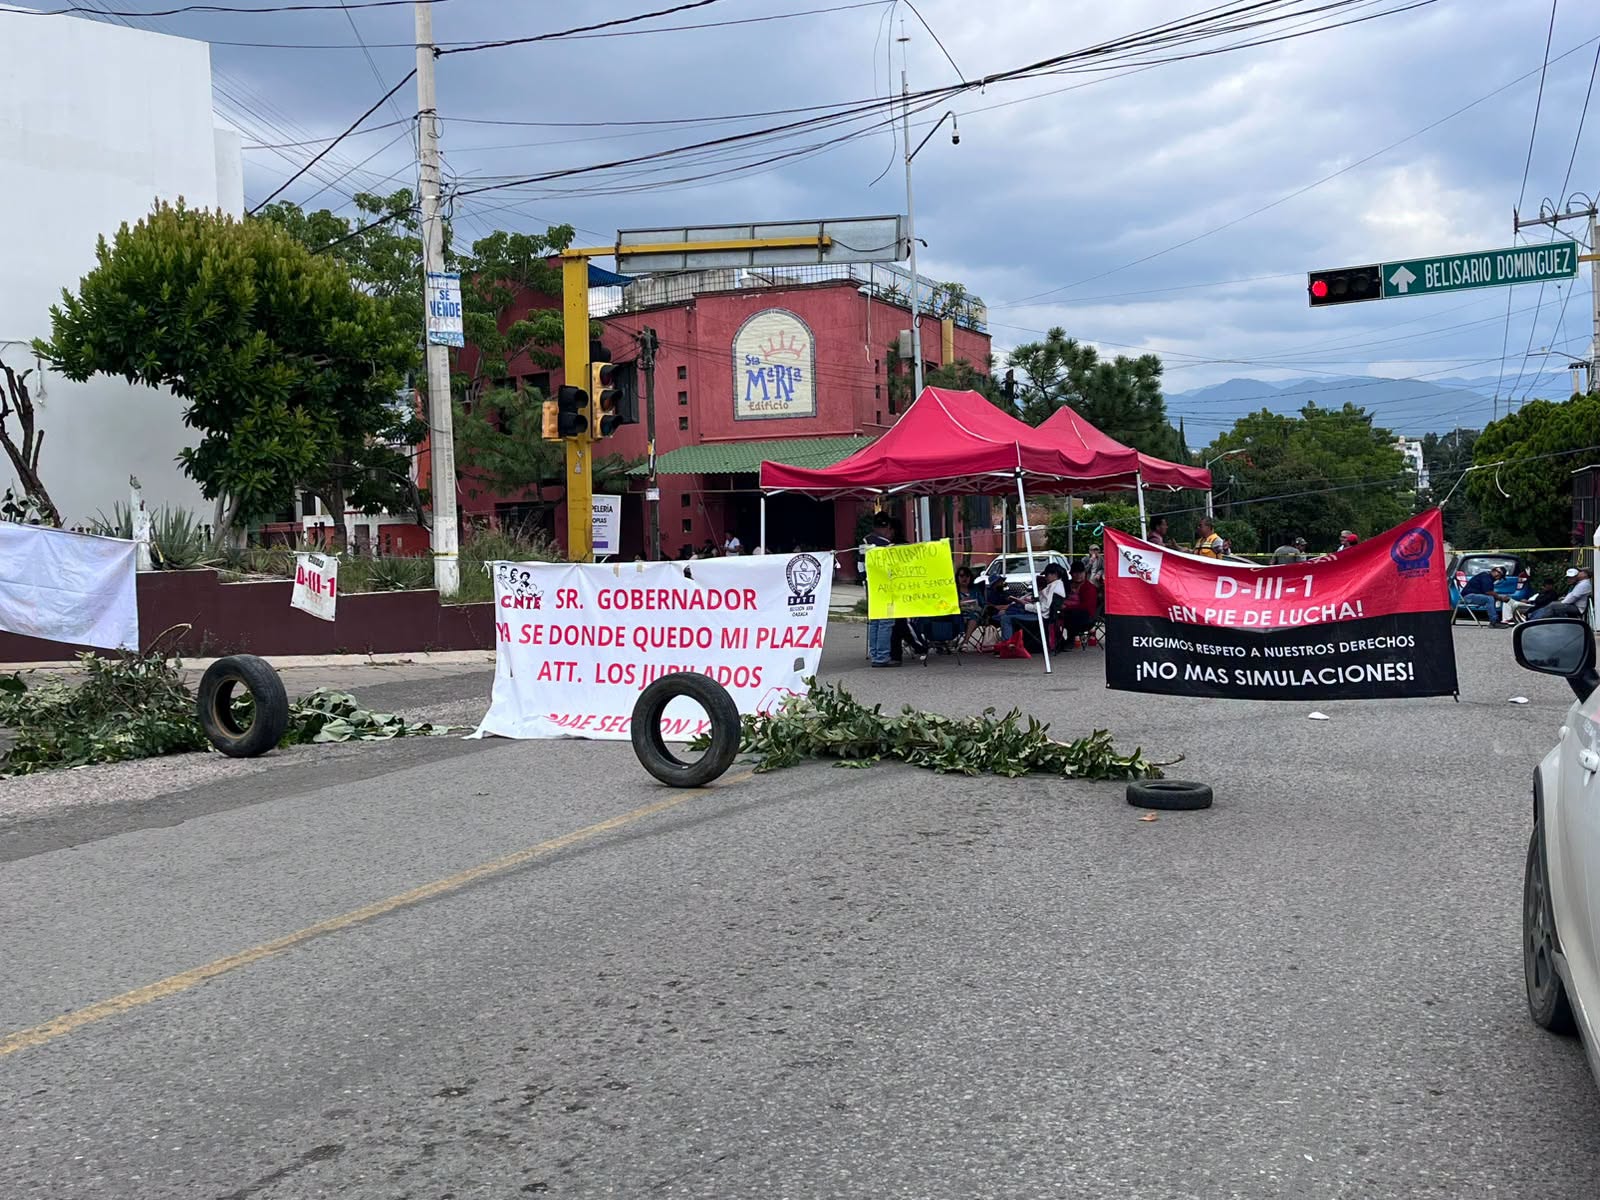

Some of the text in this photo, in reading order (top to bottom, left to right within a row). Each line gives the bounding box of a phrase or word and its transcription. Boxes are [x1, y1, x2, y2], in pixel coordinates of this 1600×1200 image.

[1425, 248, 1571, 288] BELISARIO DOMINGUEZ
[439, 290, 450, 300] SE
[430, 301, 461, 318] VENDE
[745, 355, 760, 365] Sta
[749, 401, 789, 411] Edificio
[1215, 574, 1313, 600] D-III-1
[501, 595, 541, 610] CNTE
[556, 588, 757, 610] SR. GOBERNADOR
[1168, 600, 1364, 626] ¡EN PIE DE LUCHA!
[519, 624, 543, 645] SE
[550, 625, 625, 647] DONDE
[633, 627, 712, 652] QUEDO
[721, 628, 748, 649] MI
[756, 626, 823, 649] PLAZA
[1132, 635, 1415, 657] EXIGIMOS RESPETO A NUESTROS DERECHOS
[537, 661, 583, 683] ATT.
[595, 663, 636, 685] LOS
[1136, 661, 1415, 686] ¡NO MAS SIMULACIONES!
